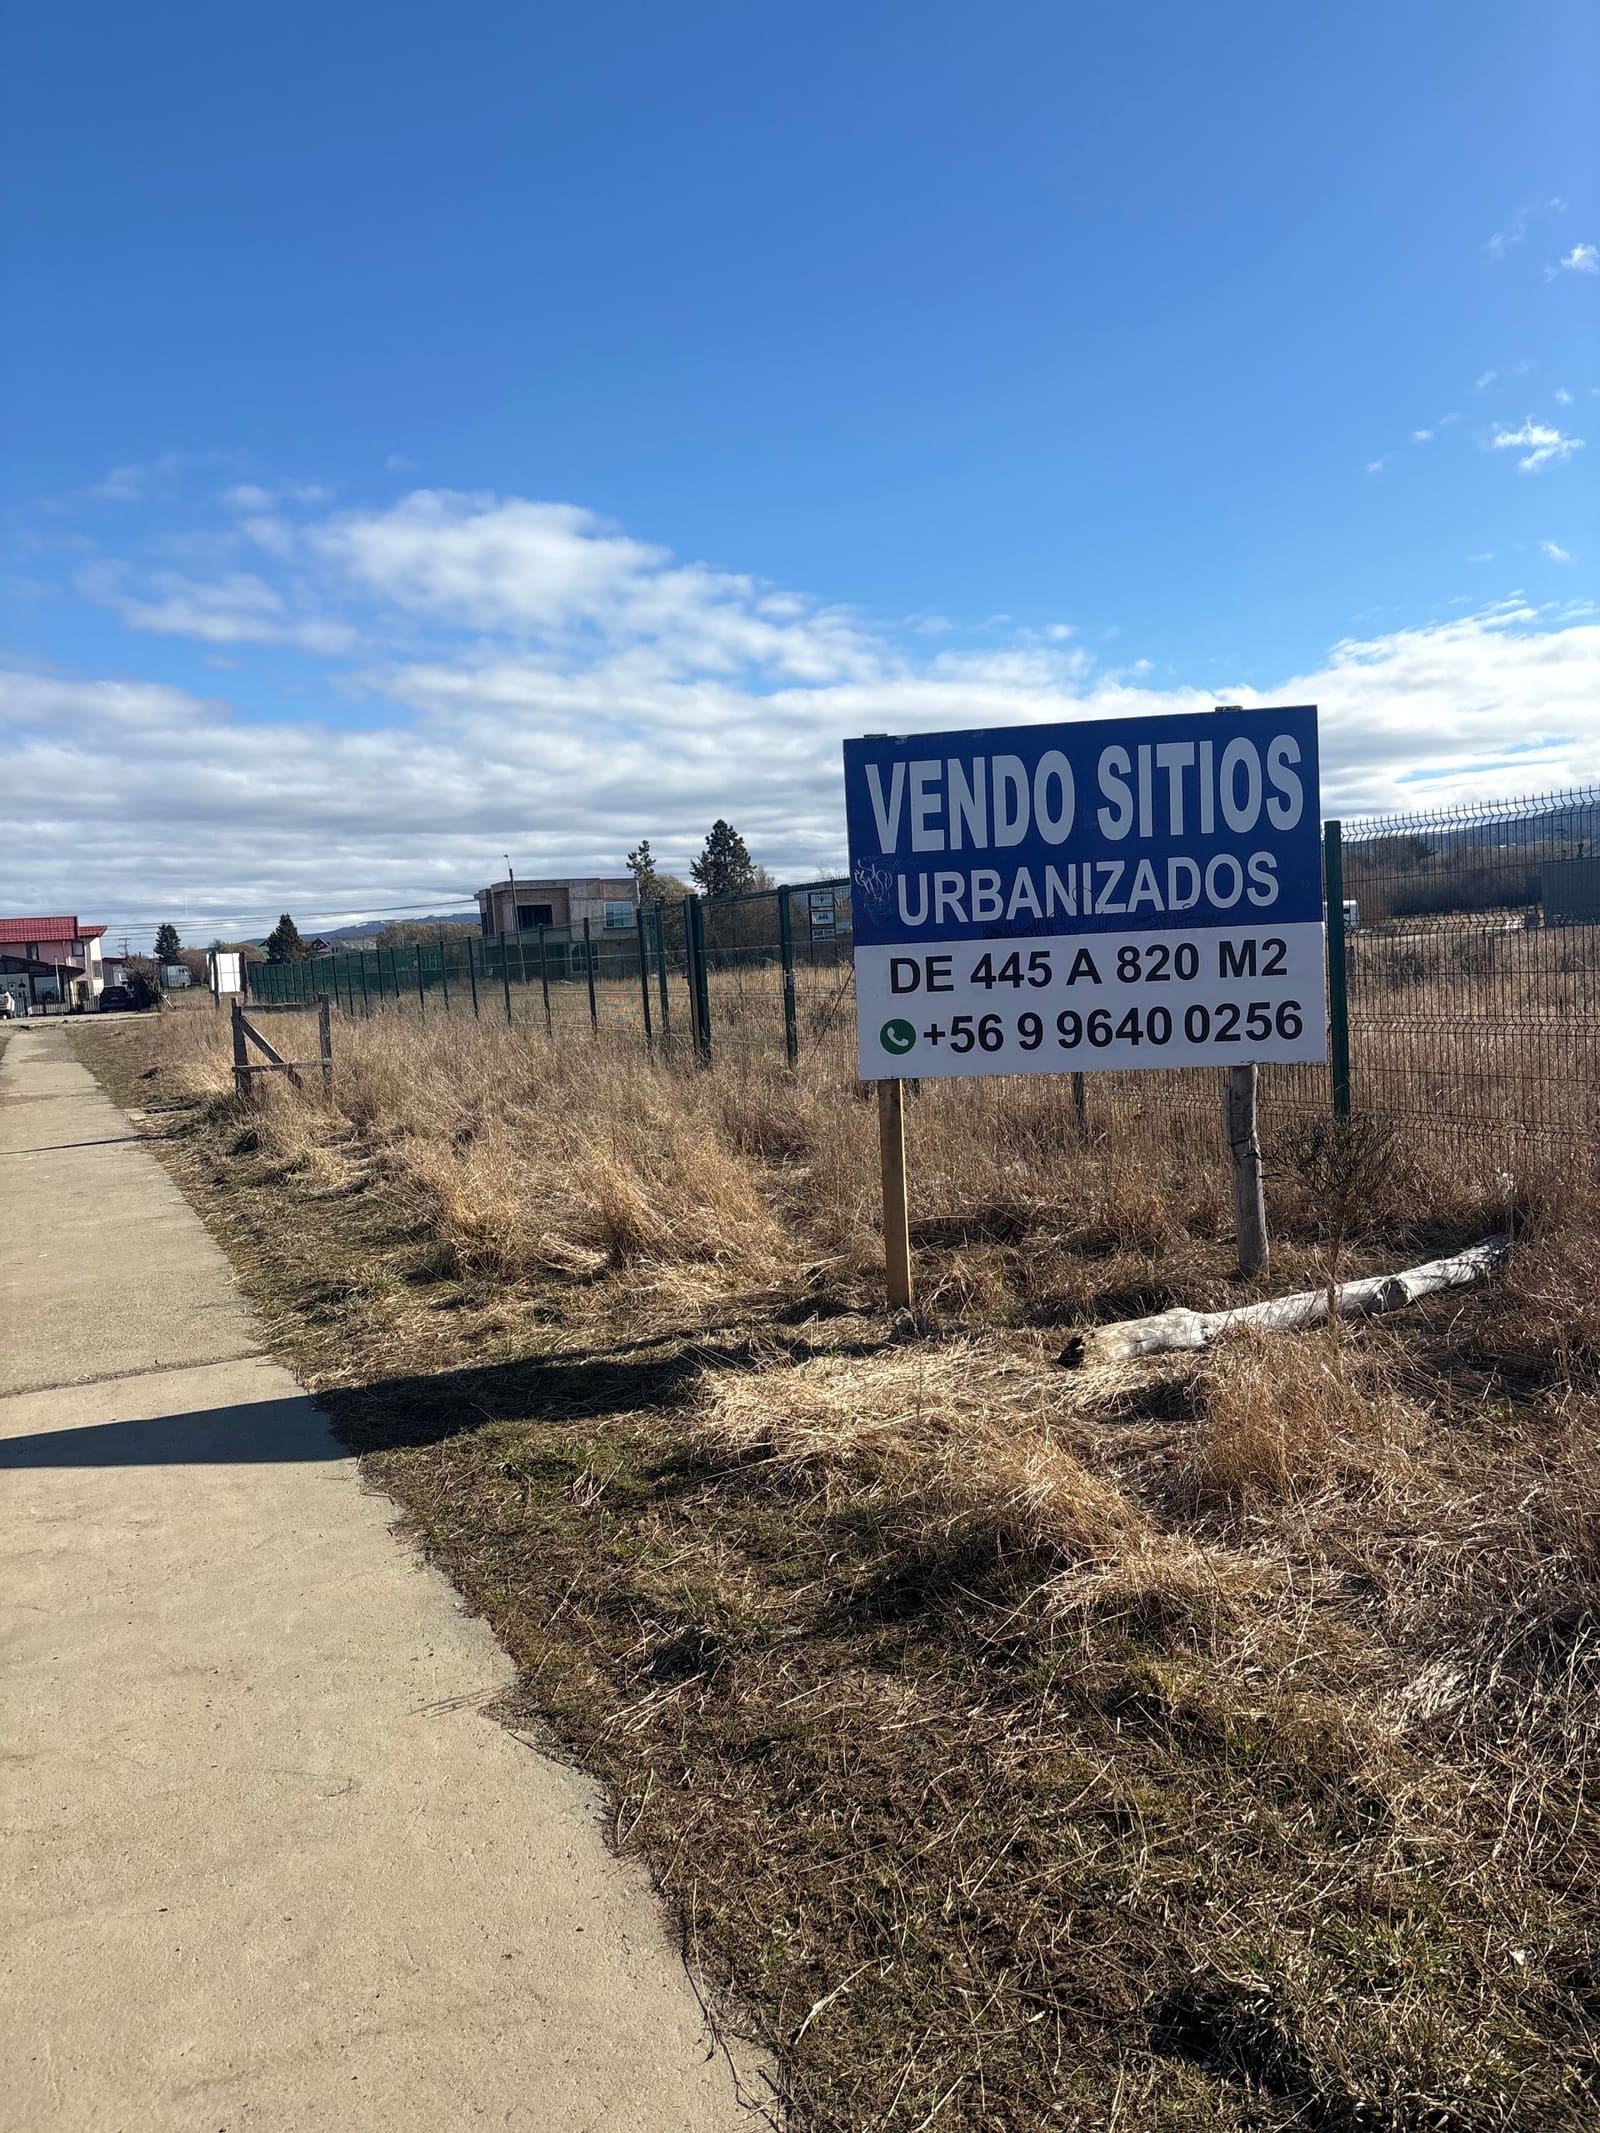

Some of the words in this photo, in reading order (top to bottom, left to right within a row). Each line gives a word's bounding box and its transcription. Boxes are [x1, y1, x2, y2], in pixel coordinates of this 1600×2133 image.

[864, 750, 1076, 854] VENDO
[1097, 735, 1303, 841] SITIOS
[897, 851, 1279, 926] URBANIZADOS
[890, 955, 954, 994] DE
[970, 950, 1052, 989] 445
[1066, 948, 1102, 985] A
[1117, 942, 1199, 983] 820
[1219, 938, 1288, 978] M2
[923, 1013, 1004, 1053] +56
[1017, 1012, 1043, 1050] 9
[1057, 1006, 1172, 1048] 9640
[1184, 1000, 1303, 1043] 0256
